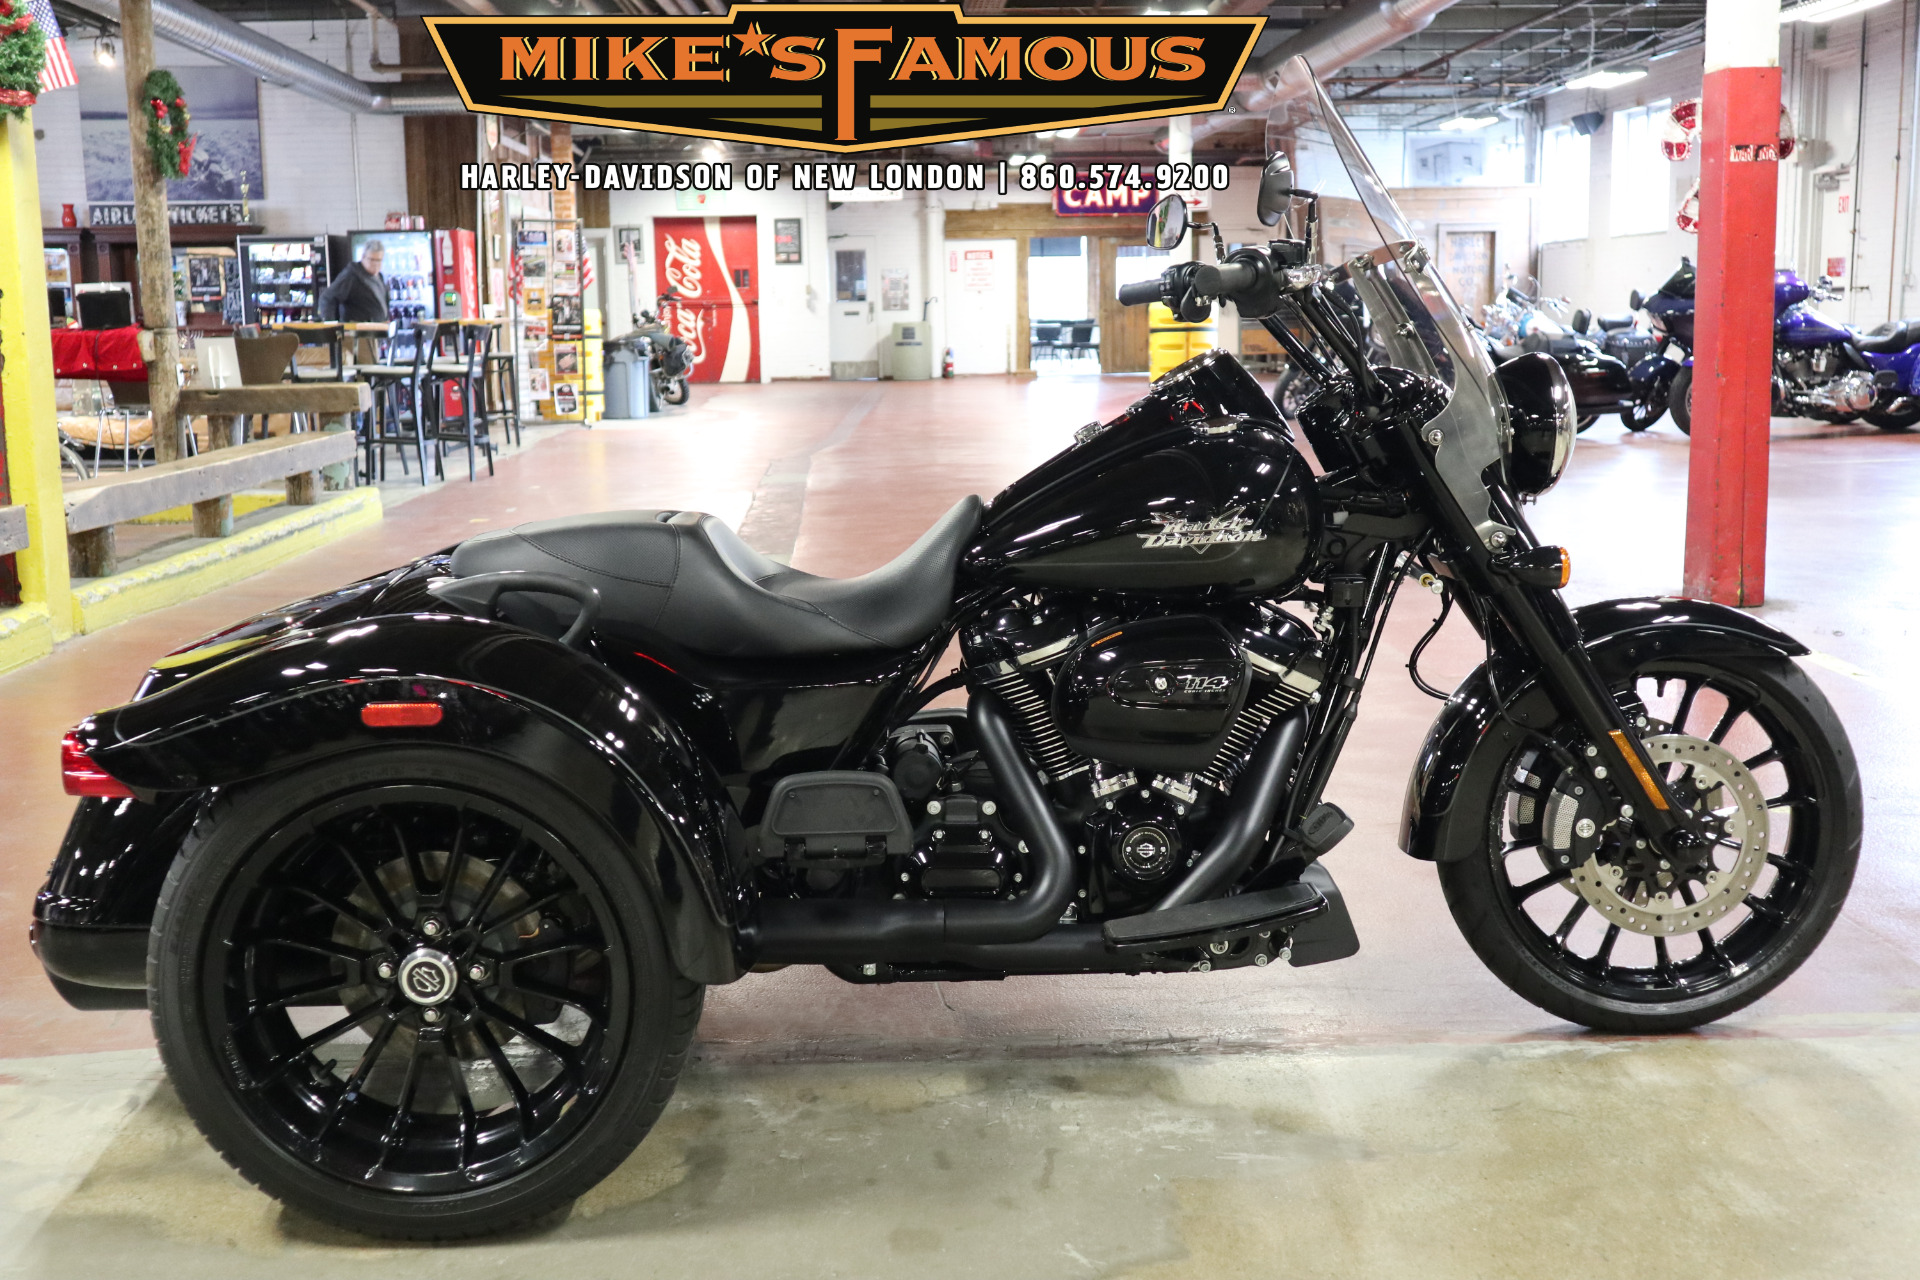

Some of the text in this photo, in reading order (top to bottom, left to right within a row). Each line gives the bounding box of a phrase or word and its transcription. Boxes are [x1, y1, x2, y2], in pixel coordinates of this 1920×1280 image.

[1732, 145, 1777, 161] WARING
[1063, 185, 1150, 208] CAMP
[1838, 195, 1850, 213] EXIT
[1178, 675, 1229, 690] 114
